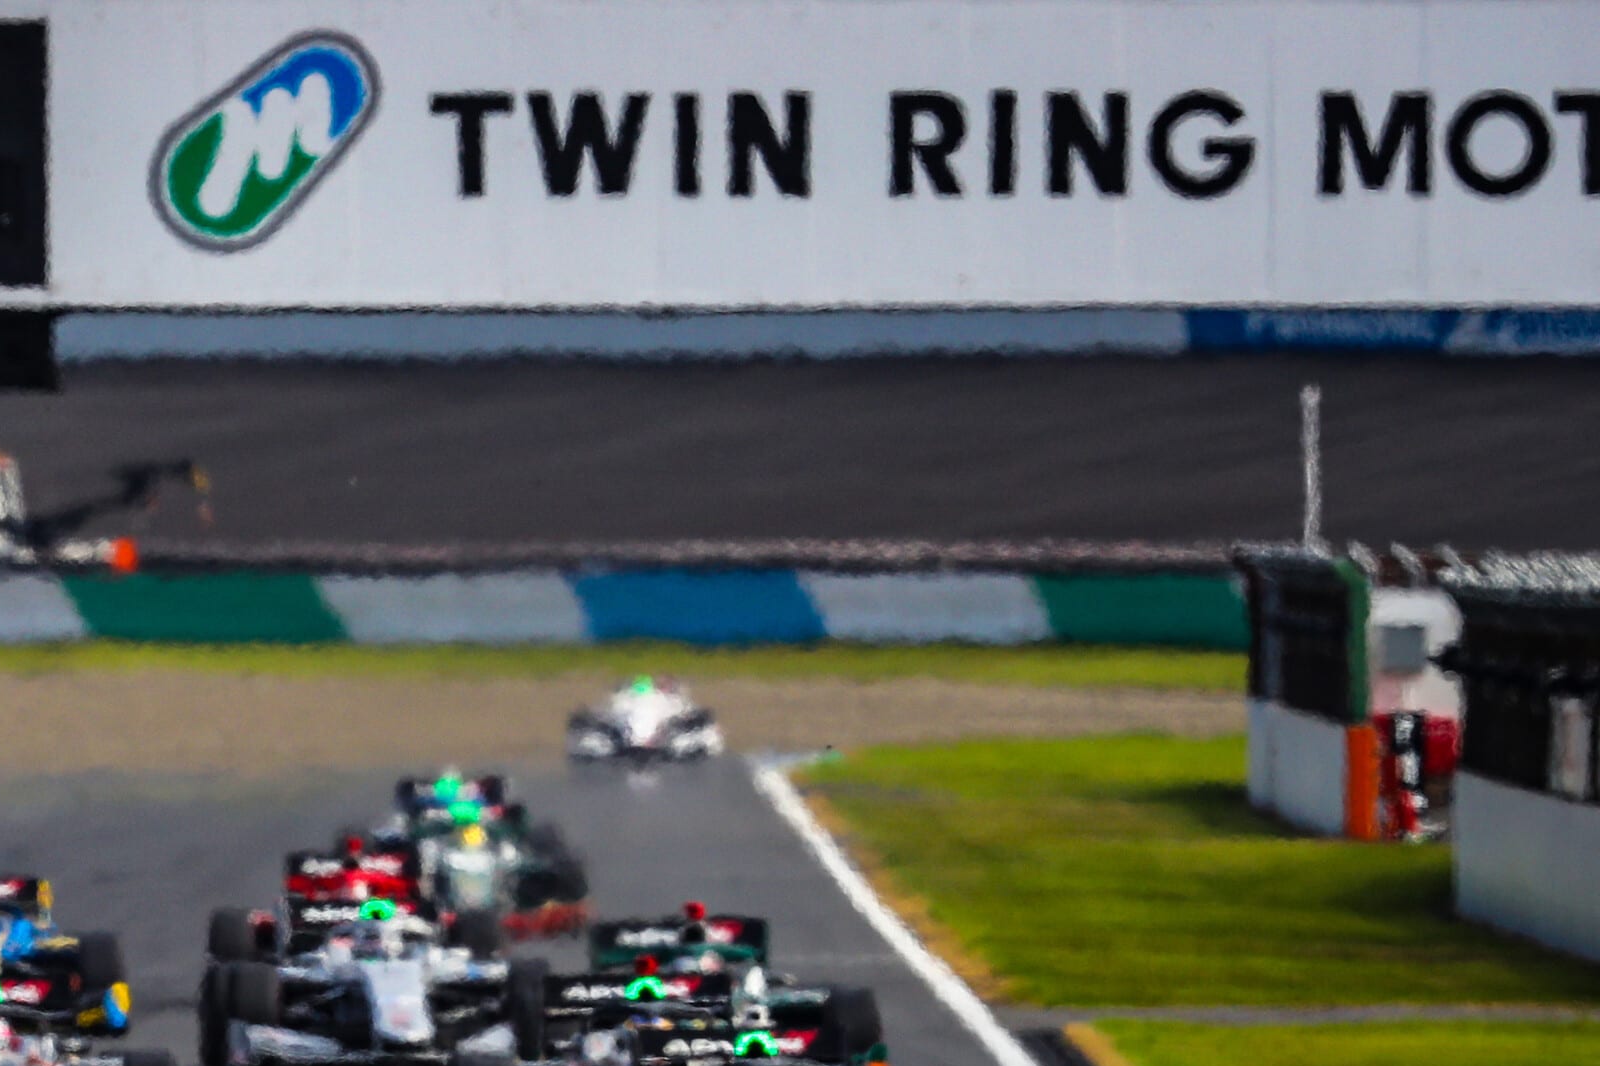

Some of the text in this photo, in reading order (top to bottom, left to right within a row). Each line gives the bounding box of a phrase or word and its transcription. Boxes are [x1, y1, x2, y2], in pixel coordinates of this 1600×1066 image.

[430, 89, 1600, 200] TWIN RING MOT
